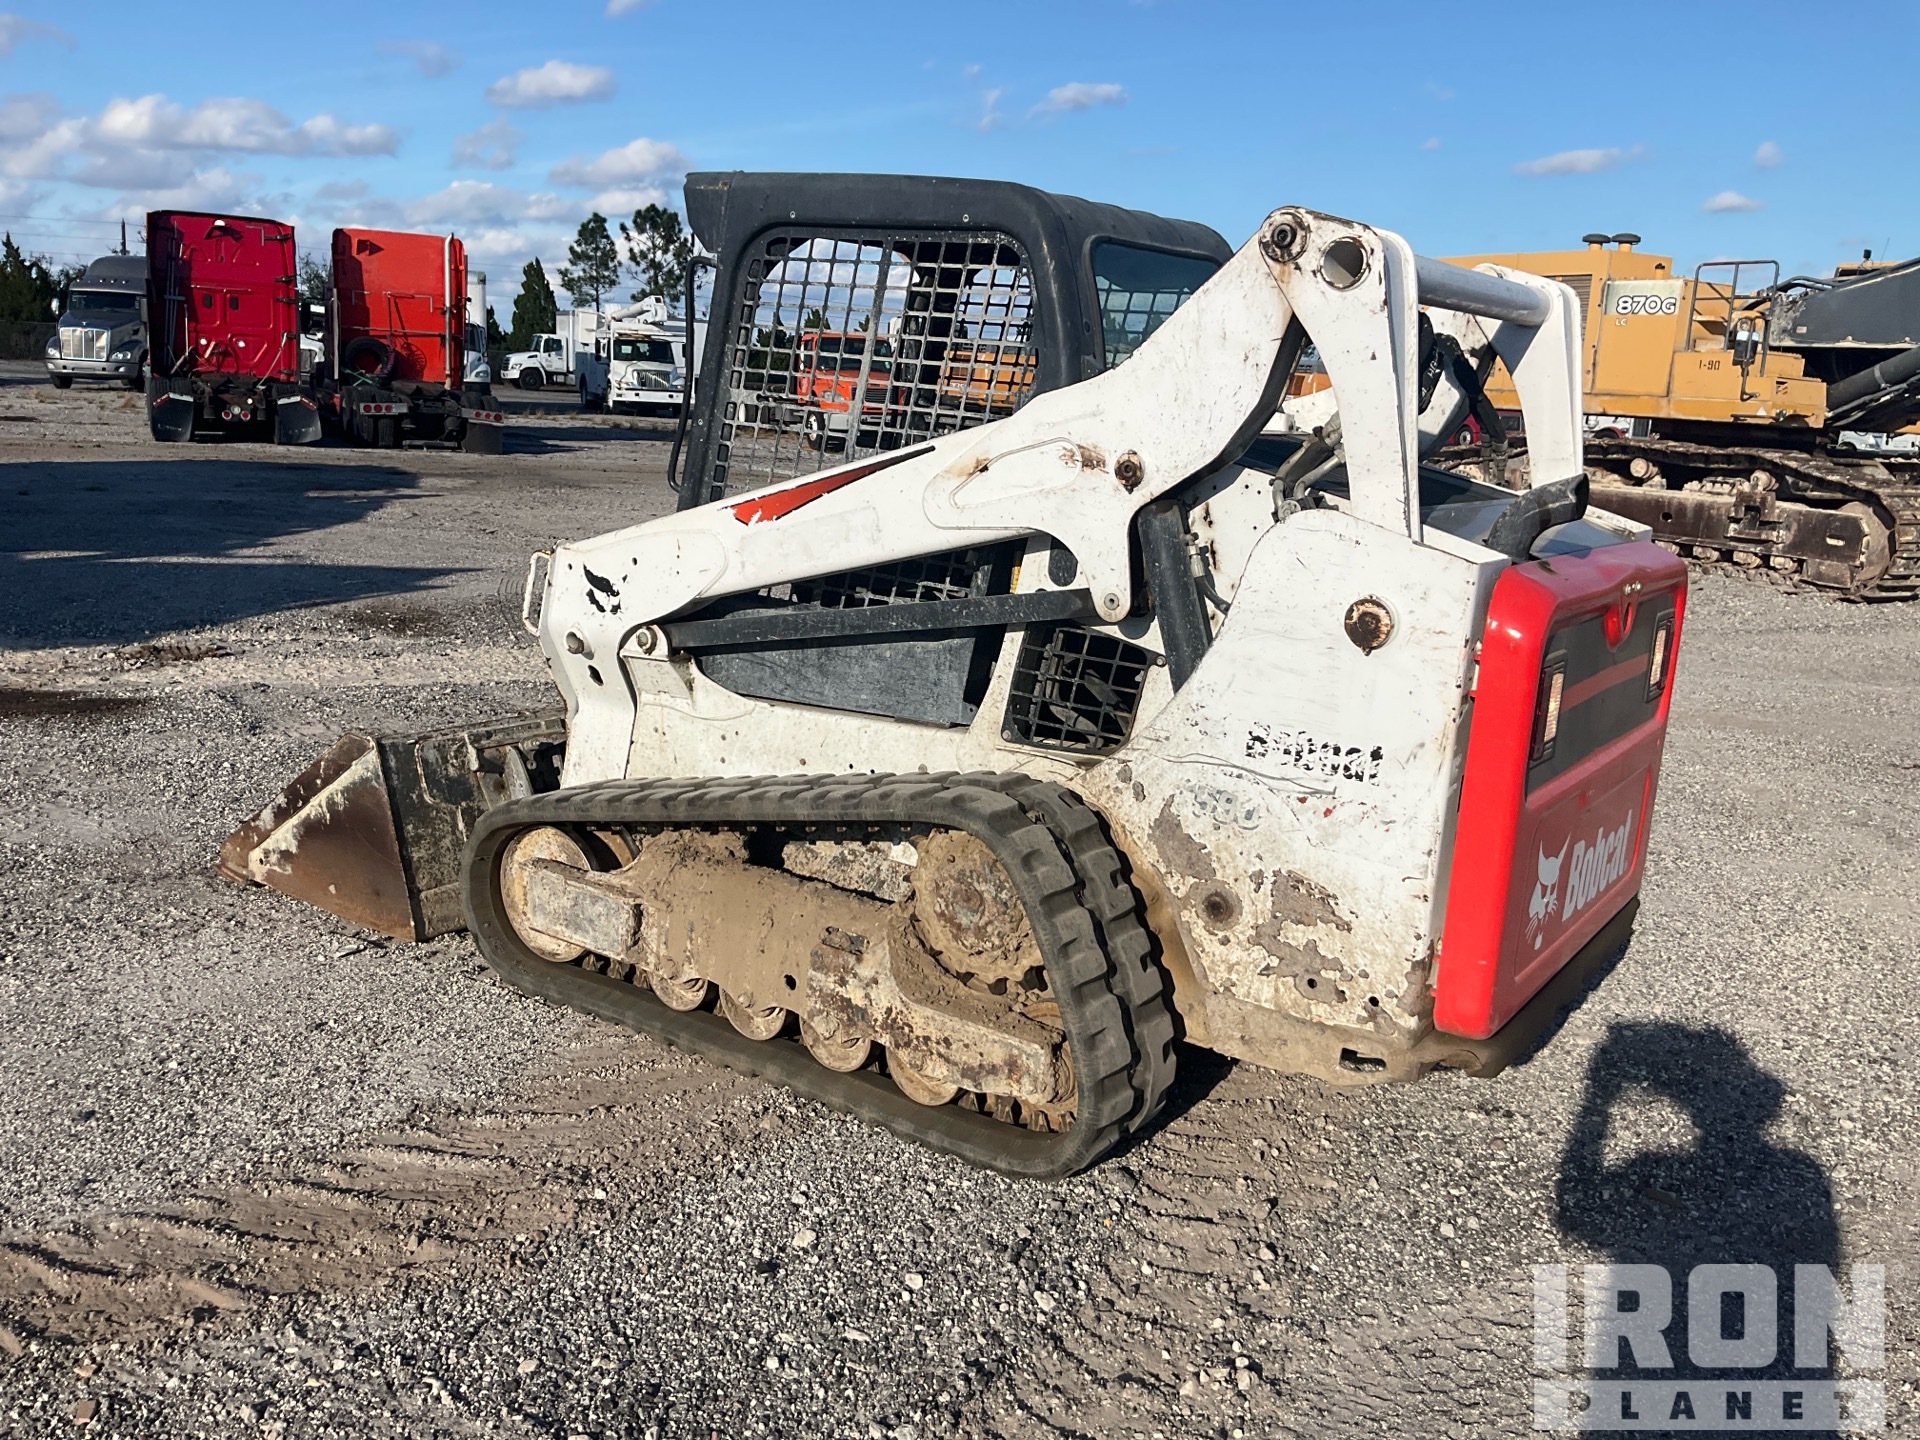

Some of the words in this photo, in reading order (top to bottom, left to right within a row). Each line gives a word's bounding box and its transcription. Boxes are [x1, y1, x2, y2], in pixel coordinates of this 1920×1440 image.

[1616, 295, 1677, 315] 870G
[1615, 318, 1627, 326] LC
[1562, 809, 1632, 921] Bobcat
